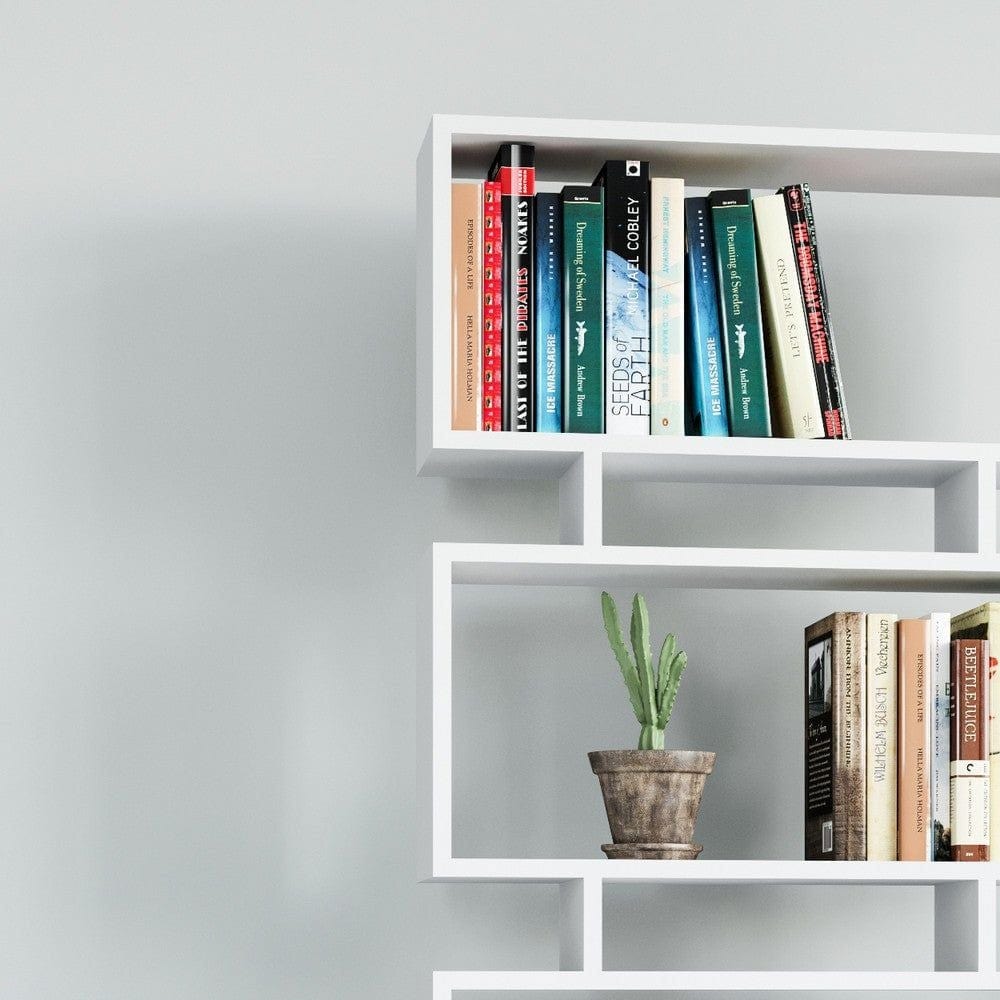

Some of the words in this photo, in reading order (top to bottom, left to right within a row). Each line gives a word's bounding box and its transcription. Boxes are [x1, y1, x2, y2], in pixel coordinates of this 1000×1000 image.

[466, 219, 474, 253] EPISODES
[516, 200, 528, 255] NOAKES
[626, 197, 640, 251] COBLEY
[793, 221, 809, 244] THE
[466, 255, 474, 266] OF
[574, 222, 586, 266] Dreaming
[726, 225, 738, 269] Dreaming
[466, 274, 474, 290] LIFE
[576, 269, 586, 278] of
[626, 256, 640, 315] MICHAEL
[776, 257, 794, 317] PRETEND
[797, 246, 820, 311] DOOMSDAY
[516, 267, 528, 332] PIRATES
[575, 278, 586, 312] Sweden
[731, 281, 743, 315] Sweden
[466, 315, 474, 340] HELLA
[611, 336, 630, 352] of
[807, 311, 829, 365] MACHINE
[466, 341, 474, 367] MARIA
[516, 337, 528, 364] THE
[546, 333, 557, 393] MASSACRE
[707, 336, 720, 396] MASSACRE
[466, 368, 474, 402] HOLMAN
[516, 373, 528, 389] OF
[576, 364, 585, 391] Andrew
[611, 357, 630, 416] SEEDS
[739, 367, 749, 394] Andrew
[516, 396, 528, 430] LAST
[546, 395, 557, 414] ICE
[576, 394, 585, 417] Brown
[712, 397, 722, 416] ICE
[742, 396, 751, 420] Brown
[874, 687, 888, 728] BUSCH
[964, 646, 977, 742] BEETLEJUICE
[874, 730, 887, 783] WILHELM
